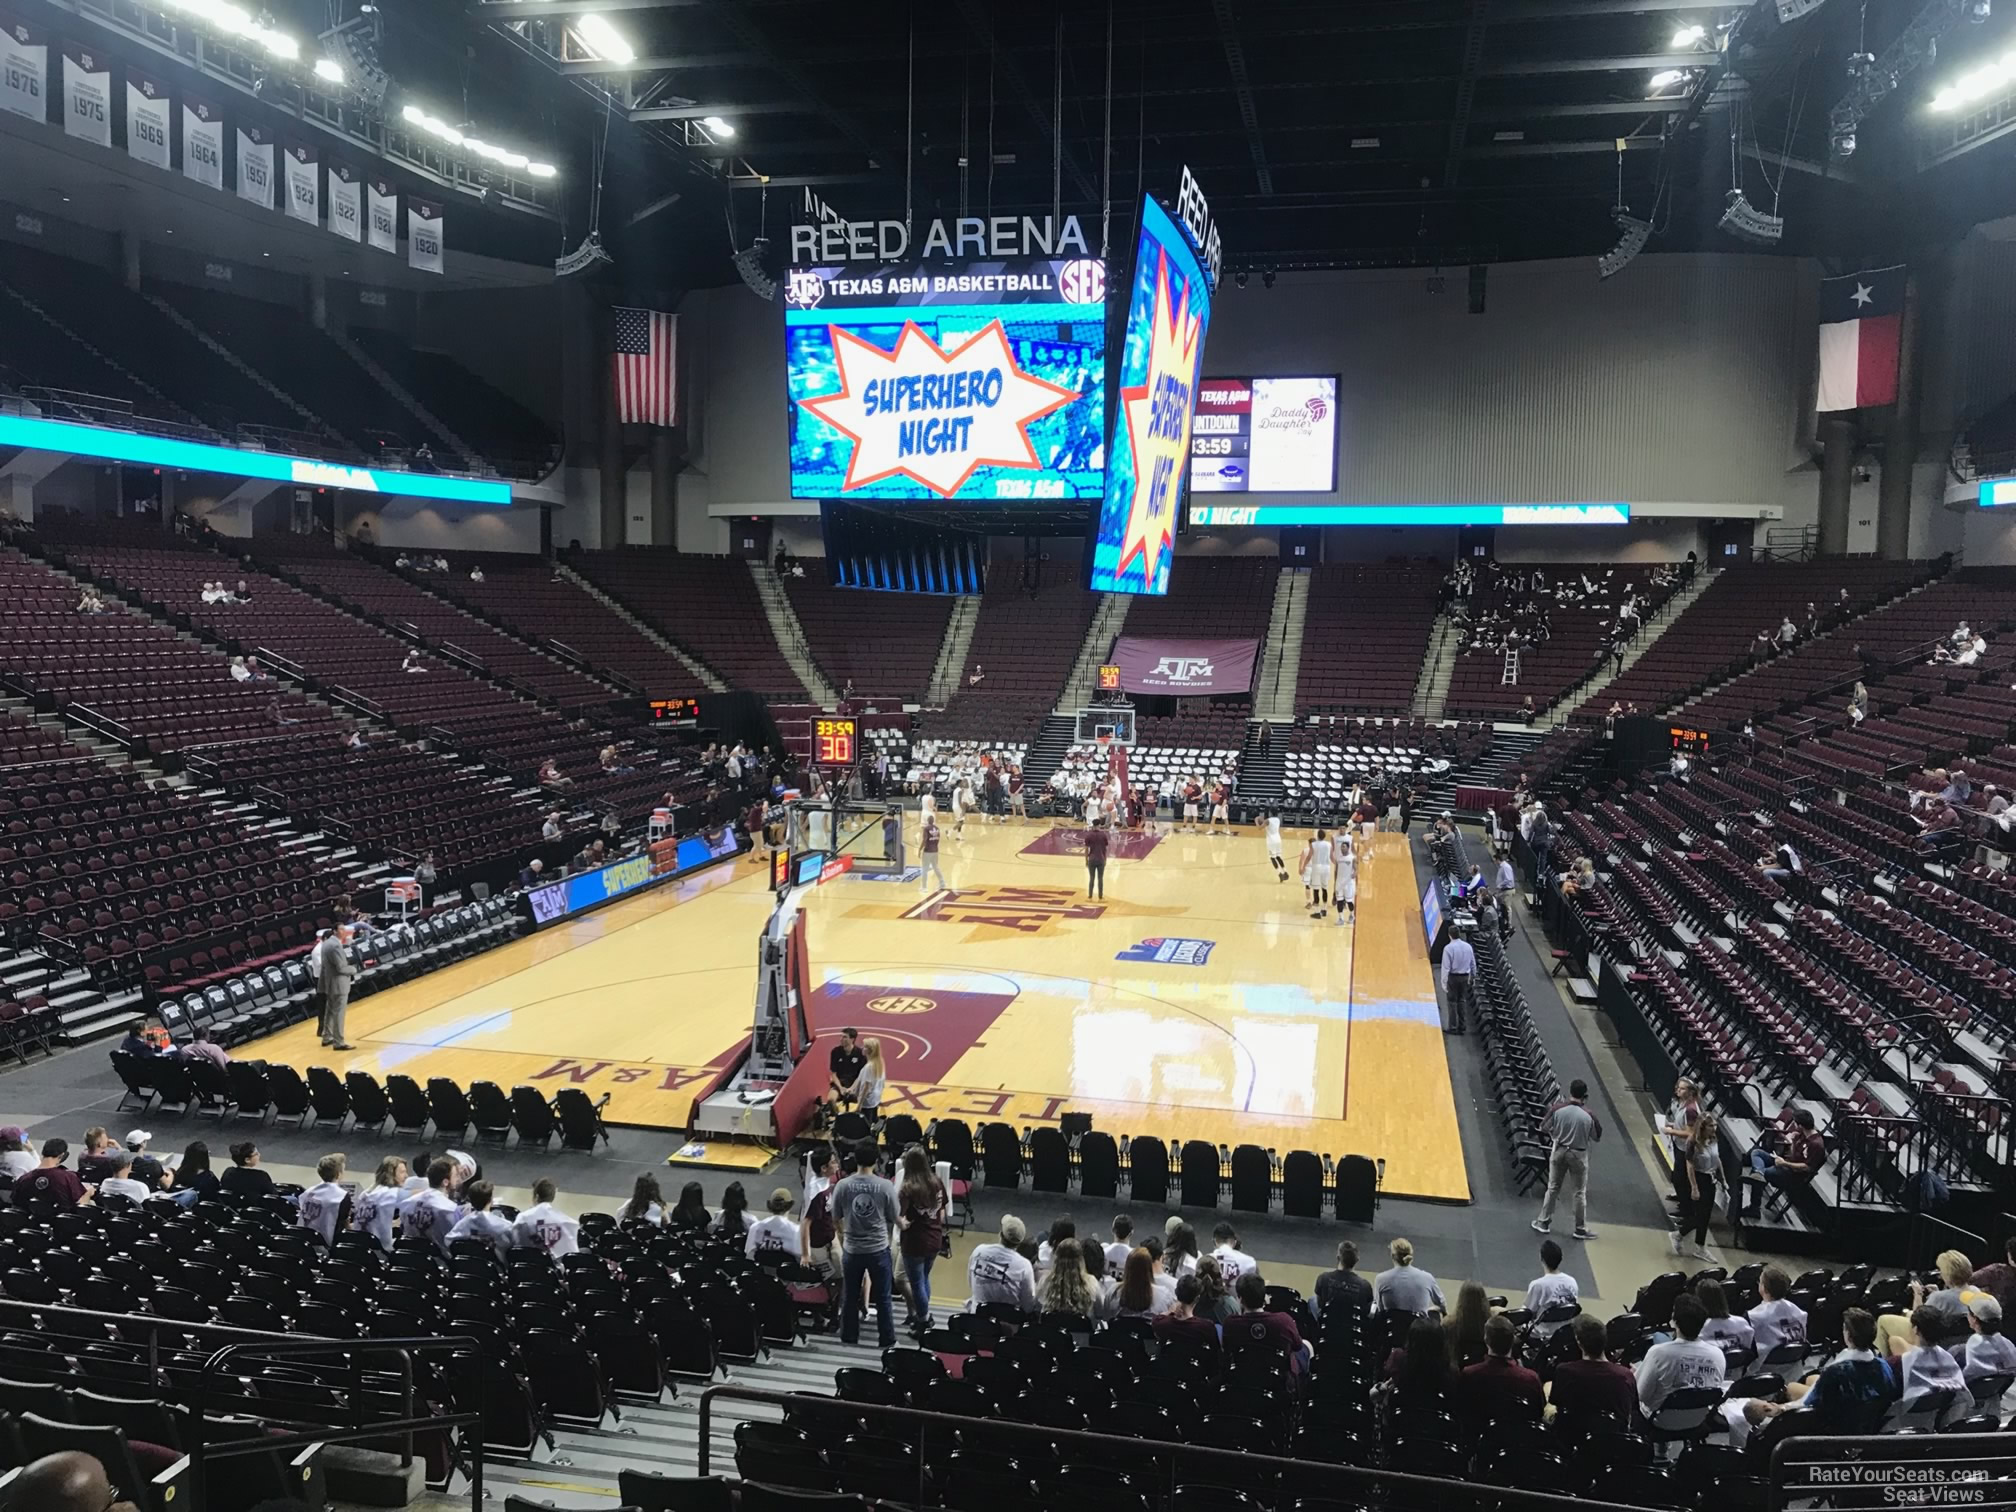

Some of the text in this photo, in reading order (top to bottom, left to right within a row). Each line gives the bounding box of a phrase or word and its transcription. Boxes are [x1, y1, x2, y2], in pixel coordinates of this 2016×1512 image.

[4, 67, 39, 97] 1976
[73, 95, 104, 122] 1975
[134, 119, 164, 146] 1969
[190, 141, 217, 167] 1964
[244, 163, 267, 187] 1951
[295, 185, 314, 205] 923
[1177, 164, 1207, 248] REED
[334, 199, 355, 222] 1922
[373, 214, 392, 234] 1921
[415, 236, 438, 255] 1920
[791, 220, 908, 263] REED
[922, 215, 1088, 257] ARENA
[829, 275, 1052, 296] TEXAS A&M BASKETBALL
[1063, 260, 1105, 304] SEC
[863, 367, 1003, 417] SUPERHERO
[1200, 391, 1228, 402] TEXAS
[1193, 414, 1239, 430] UNTDOWN
[1271, 406, 1309, 419] Daddy
[1258, 417, 1312, 432] Daughter
[898, 415, 974, 458] NIGHT
[1211, 506, 1260, 525] NIGHT
[1102, 675, 1116, 687] 30
[817, 721, 854, 736] 33:59
[822, 737, 848, 760] 30
